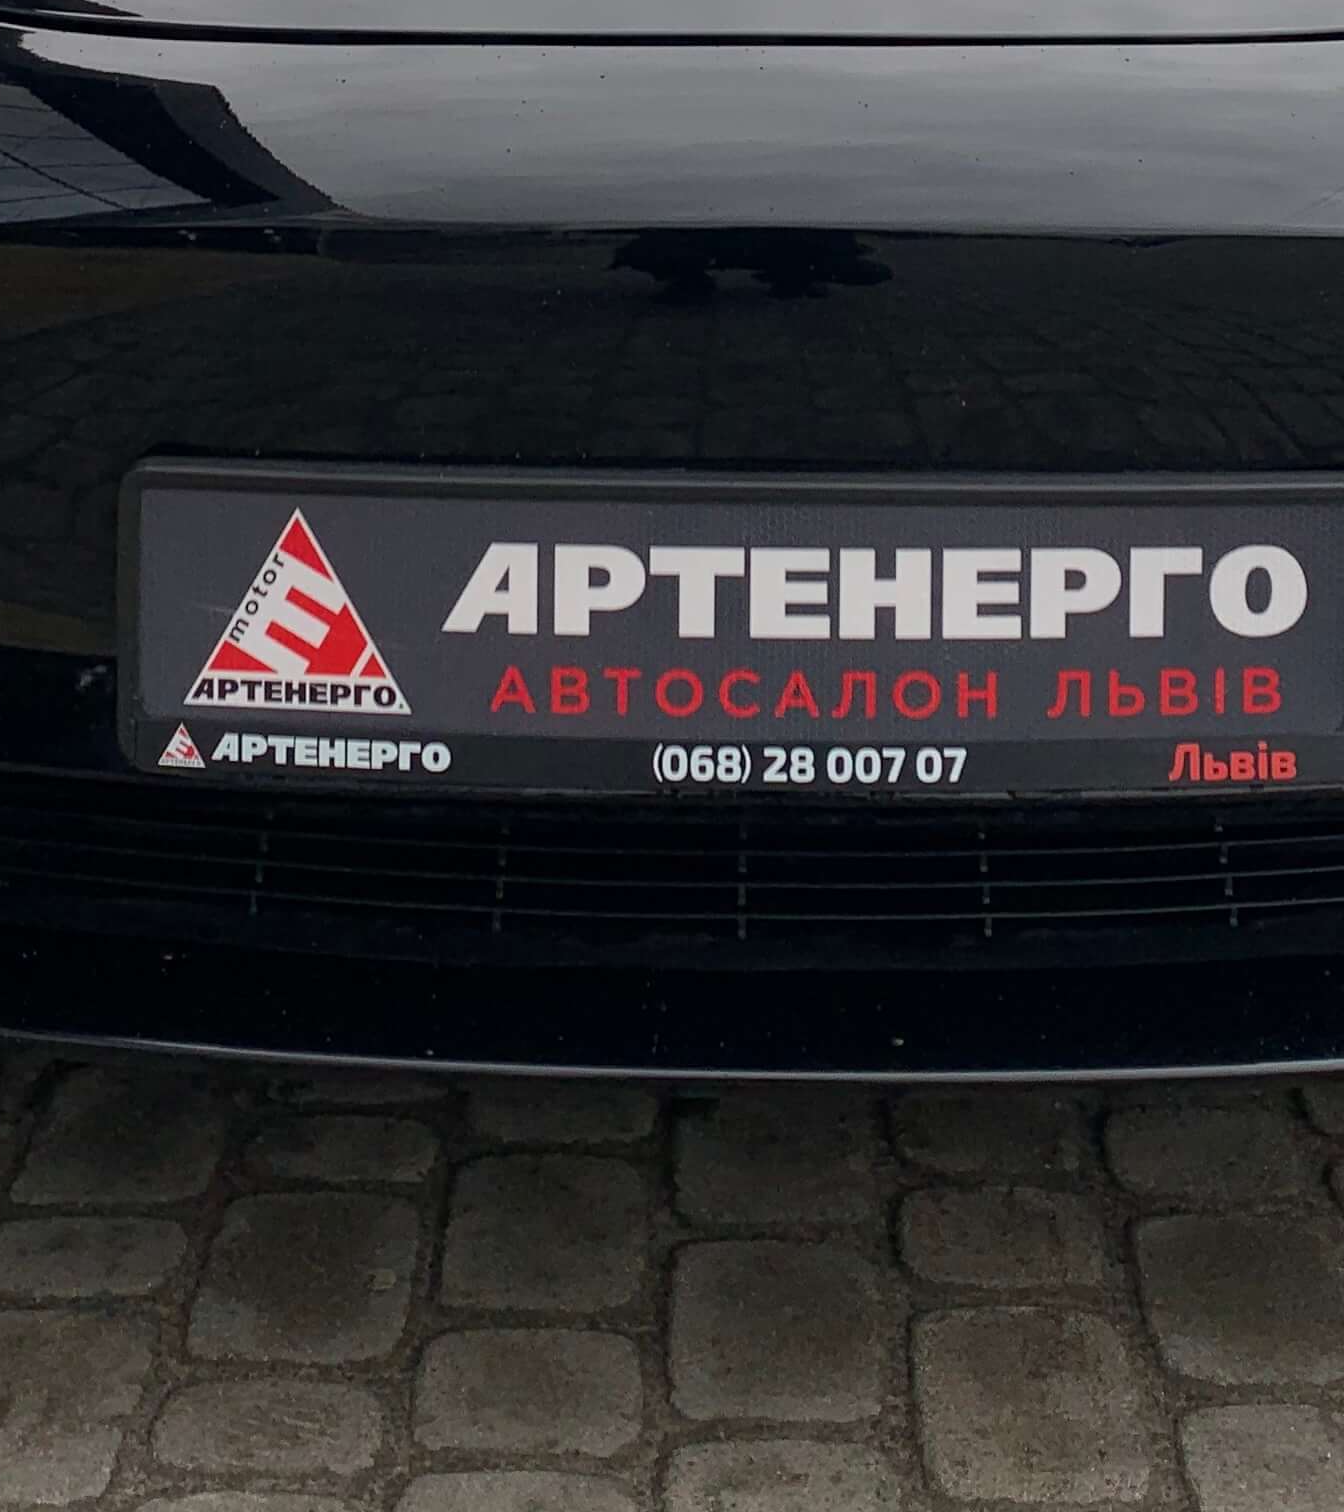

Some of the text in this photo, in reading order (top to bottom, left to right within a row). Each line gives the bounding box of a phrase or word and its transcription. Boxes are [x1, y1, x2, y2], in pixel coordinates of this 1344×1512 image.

[228, 552, 286, 644] motor
[441, 542, 1308, 640] АРТЕНЕРГО
[191, 677, 398, 709] АРТЕНЕРГО
[491, 665, 1283, 721] АВТОСАЛОН ЛЬВІВ
[211, 732, 452, 773] АРТЕНЕРГО
[652, 742, 968, 785] (068) 28 007 07
[1168, 740, 1298, 782] Львів
